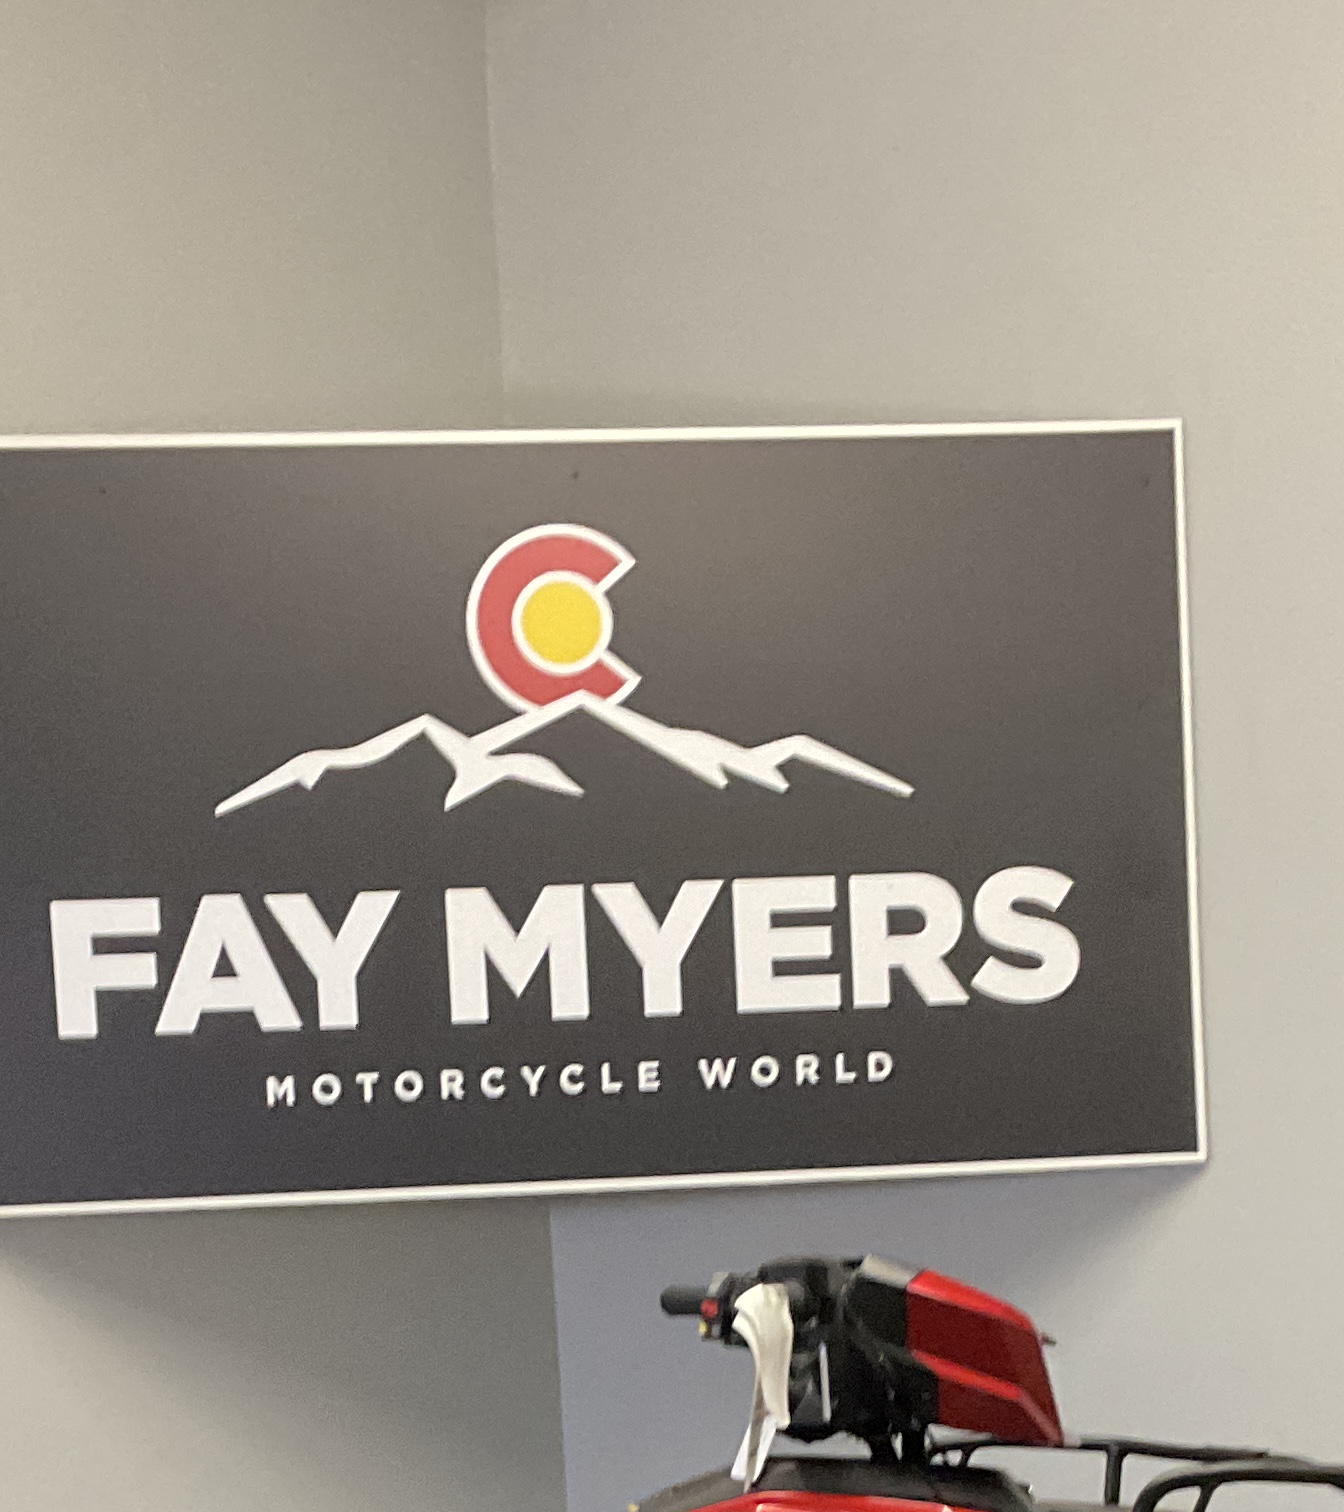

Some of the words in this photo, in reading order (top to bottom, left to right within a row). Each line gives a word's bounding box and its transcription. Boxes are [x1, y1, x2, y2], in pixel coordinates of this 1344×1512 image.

[49, 890, 402, 1040] FAY
[444, 865, 1082, 1025] MYERS
[266, 1060, 662, 1107] MOTORCYCLE
[698, 1051, 894, 1089] WORLD
